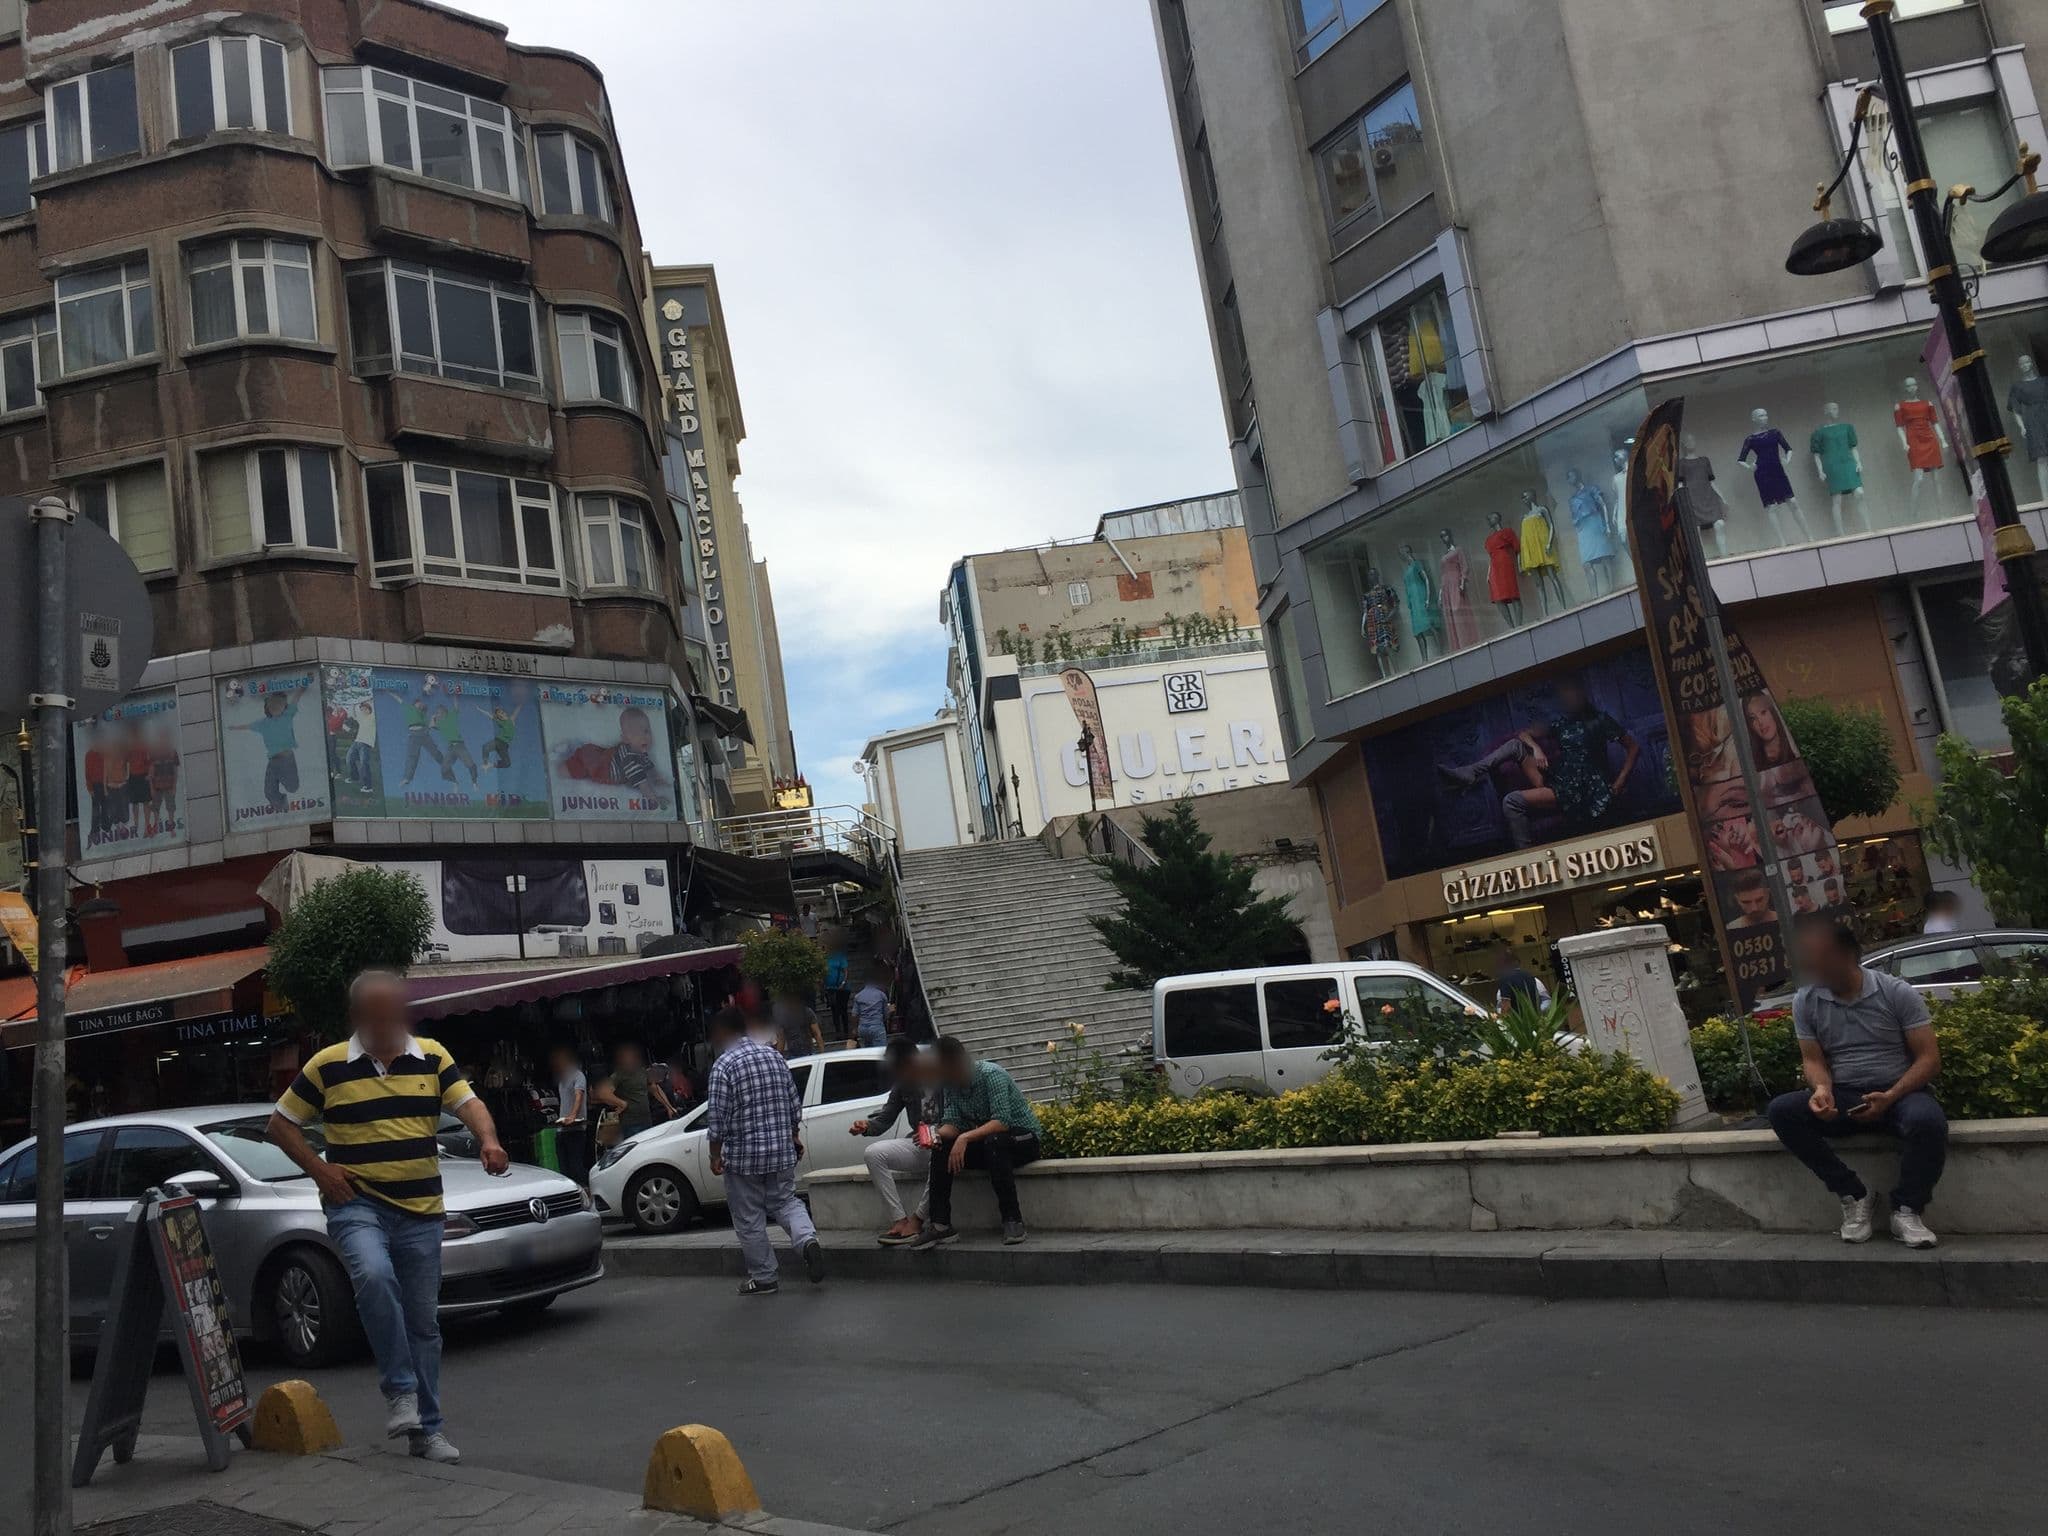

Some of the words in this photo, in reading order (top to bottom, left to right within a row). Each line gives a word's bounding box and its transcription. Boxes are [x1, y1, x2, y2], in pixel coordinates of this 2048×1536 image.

[667, 327, 700, 434] GRAND
[685, 447, 723, 626] MARCELLO
[714, 642, 739, 752] HOTL
[1168, 674, 1201, 692] GR
[1131, 773, 1272, 805] SHOES
[561, 796, 620, 812] JUNIOR
[1565, 836, 1656, 881] SHOES
[1733, 934, 1774, 957] 0530
[1739, 956, 1776, 979] 0531
[79, 1017, 104, 1032] TINA
[106, 1012, 132, 1026] TIME
[175, 1023, 216, 1041] TINA
[218, 1014, 258, 1034] TIME
